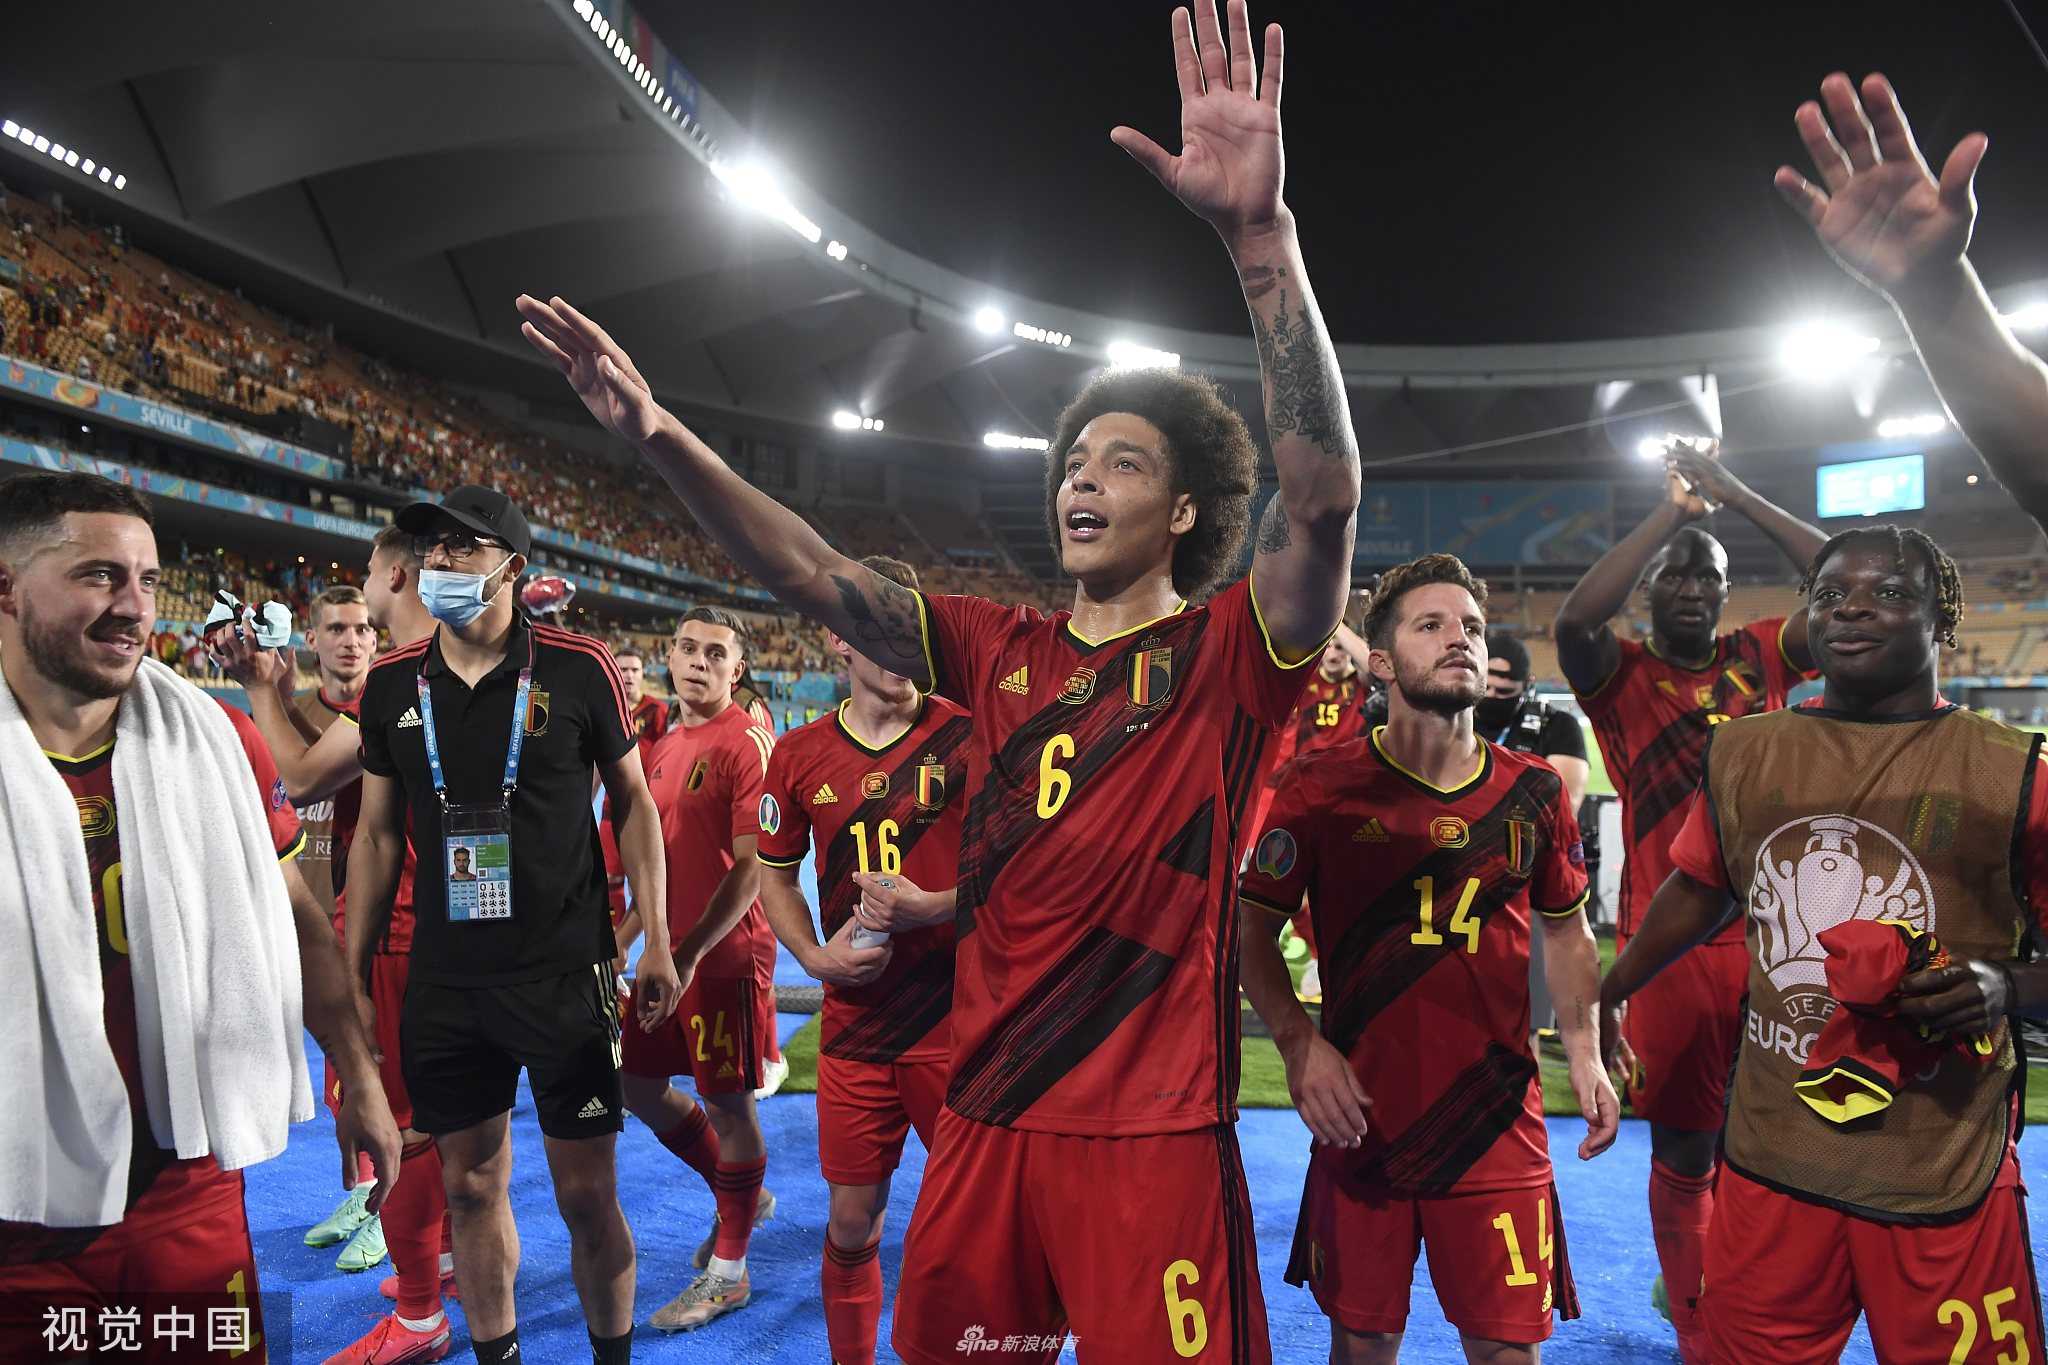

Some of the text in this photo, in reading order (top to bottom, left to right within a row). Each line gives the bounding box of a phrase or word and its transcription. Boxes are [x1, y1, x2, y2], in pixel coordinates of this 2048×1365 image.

[141, 404, 192, 435] SEVILLE
[999, 681, 1029, 695] adidas
[397, 718, 423, 728] adidas
[1316, 703, 1339, 726] 15
[1036, 733, 1075, 819] 6
[812, 795, 838, 805] adidas
[850, 818, 901, 875] 16
[1411, 875, 1481, 954] 14
[1786, 998, 1836, 1017] UEF
[690, 1011, 734, 1061] 24
[578, 1108, 608, 1118] adidas
[1493, 1199, 1553, 1287] 14
[1163, 1259, 1208, 1358] 6
[1937, 1287, 2030, 1365] 25
